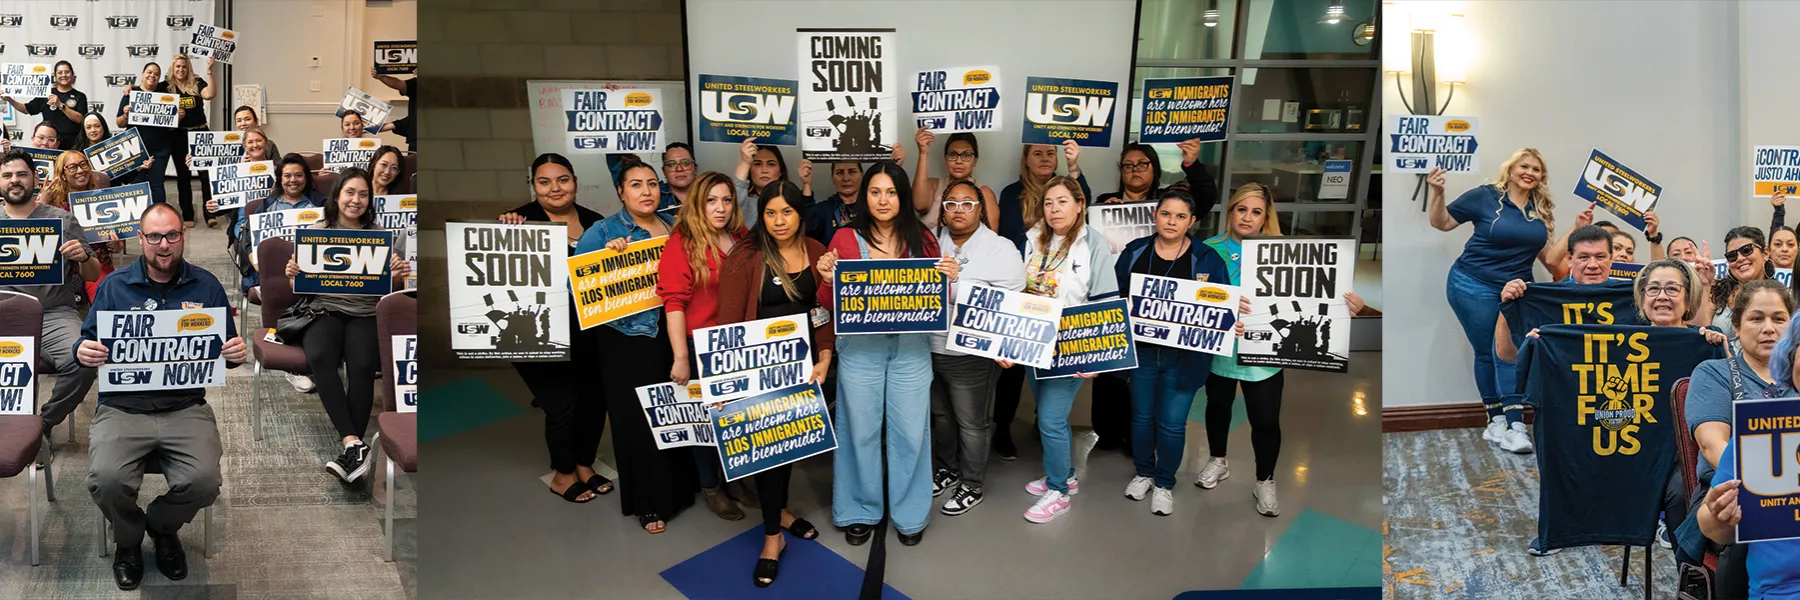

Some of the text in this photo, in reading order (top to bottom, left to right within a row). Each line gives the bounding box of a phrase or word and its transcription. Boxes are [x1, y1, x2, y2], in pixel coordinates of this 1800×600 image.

[166, 17, 194, 26] USW
[197, 24, 215, 37] FAIR
[78, 46, 105, 55] USW
[195, 36, 234, 52] CONTRACT
[810, 36, 882, 59] COMING
[212, 51, 231, 62] NOW!
[376, 49, 417, 65] USW
[7, 65, 24, 76] FAIR
[812, 60, 883, 93] SOON
[6, 75, 47, 86] CONTRACT
[704, 82, 791, 94] UNITED STEELWORKERS
[917, 71, 947, 91] FAIR
[1032, 84, 1111, 96] UNITED STEELWORKERS
[135, 92, 152, 103] FAIR
[574, 91, 607, 111] FAIR
[918, 89, 993, 112] CONTRACT
[1148, 84, 1229, 100] USW IMMIGRANTS
[134, 102, 176, 115] CONTRACT
[342, 94, 387, 125] USW
[701, 90, 796, 125] USW
[1026, 92, 1115, 127] USW
[1147, 95, 1229, 110] are welcome here
[153, 115, 175, 126] NOW!
[575, 111, 655, 131] CONTRACT
[916, 110, 994, 130] USW NOW!
[1146, 109, 1226, 124] ¡LOS INMIGRANTES
[1398, 117, 1429, 134] FAIR
[727, 129, 750, 137] LOCAL
[806, 128, 832, 137] USW
[1143, 118, 1225, 135] son bienvenidos!
[195, 133, 214, 144] FAIR
[329, 140, 349, 151] FAIR
[573, 132, 656, 151] USW NOW!
[1398, 135, 1472, 153] CONTRACT
[90, 136, 141, 171] USW
[194, 144, 241, 156] CONTRACT
[1396, 155, 1472, 171] USW NOW!
[216, 166, 238, 180] FAIR
[1326, 175, 1344, 183] NEO
[1594, 155, 1656, 194] UNITED STEELWORKERS
[1755, 167, 1783, 180] JUSTO
[217, 175, 270, 194] CONTRACT
[1584, 159, 1657, 214] USW
[98, 189, 144, 201] STEELWORKERS
[217, 196, 240, 206] USW
[73, 195, 149, 227] USW
[1596, 195, 1630, 216] LOCAL 7600
[259, 213, 284, 230] FAIR
[1101, 206, 1155, 226] COMIN
[118, 226, 133, 234] 7600
[464, 227, 551, 252] COMING
[329, 237, 385, 245] STEELWORKERS
[297, 244, 390, 275] USW
[1257, 243, 1338, 266] COMING
[465, 252, 552, 287] SOON
[575, 263, 600, 278] USW
[578, 266, 643, 291] are welcome
[840, 268, 942, 284] USW IMMIGRANTS
[345, 280, 364, 288] 7600
[580, 272, 659, 306] ¡LOS INMIGRANT
[840, 280, 943, 296] are welcome here
[1141, 277, 1178, 300] FAIR
[1255, 266, 1337, 299] SOON
[841, 295, 942, 311] ¡LOS INMIGRANTES
[967, 285, 1005, 312] FAIR
[583, 304, 602, 318] son
[840, 306, 943, 324] son bienvenidos!
[1138, 298, 1228, 329] CONTRACT
[1562, 301, 1615, 325] IT'S
[112, 314, 155, 338] FAIR
[457, 324, 490, 335] USW
[962, 307, 1050, 342] CONTRACT
[1101, 321, 1127, 335] here
[708, 325, 746, 351] FAIR
[1058, 333, 1128, 355] INMIGRANTES
[1134, 324, 1226, 352] USW NOW!
[1243, 331, 1273, 341] USW
[112, 336, 215, 364] CONTRACT
[711, 339, 801, 375] CONTRACT
[955, 334, 992, 352] USW
[997, 337, 1046, 364] NOW!
[1058, 344, 1129, 368] bienvenidos!
[1583, 332, 1650, 363] IT'S
[108, 361, 215, 386] USW NOW!
[709, 362, 804, 396] USW NOW!
[1571, 362, 1660, 395] TIME
[1729, 360, 1742, 389] NAUTICA
[647, 385, 678, 406] FAIR
[718, 389, 817, 428] USW IMMIGRANTS
[1595, 408, 1636, 420] UNION PROUD
[722, 399, 820, 440] are welcome here
[1747, 416, 1800, 431] UNITED
[660, 430, 689, 443] USW
[724, 414, 825, 456] ¡LOS INMIGRANTES
[1592, 424, 1641, 456] US
[728, 424, 827, 470] son bienvenidos!
[1760, 497, 1787, 507] UNITY
